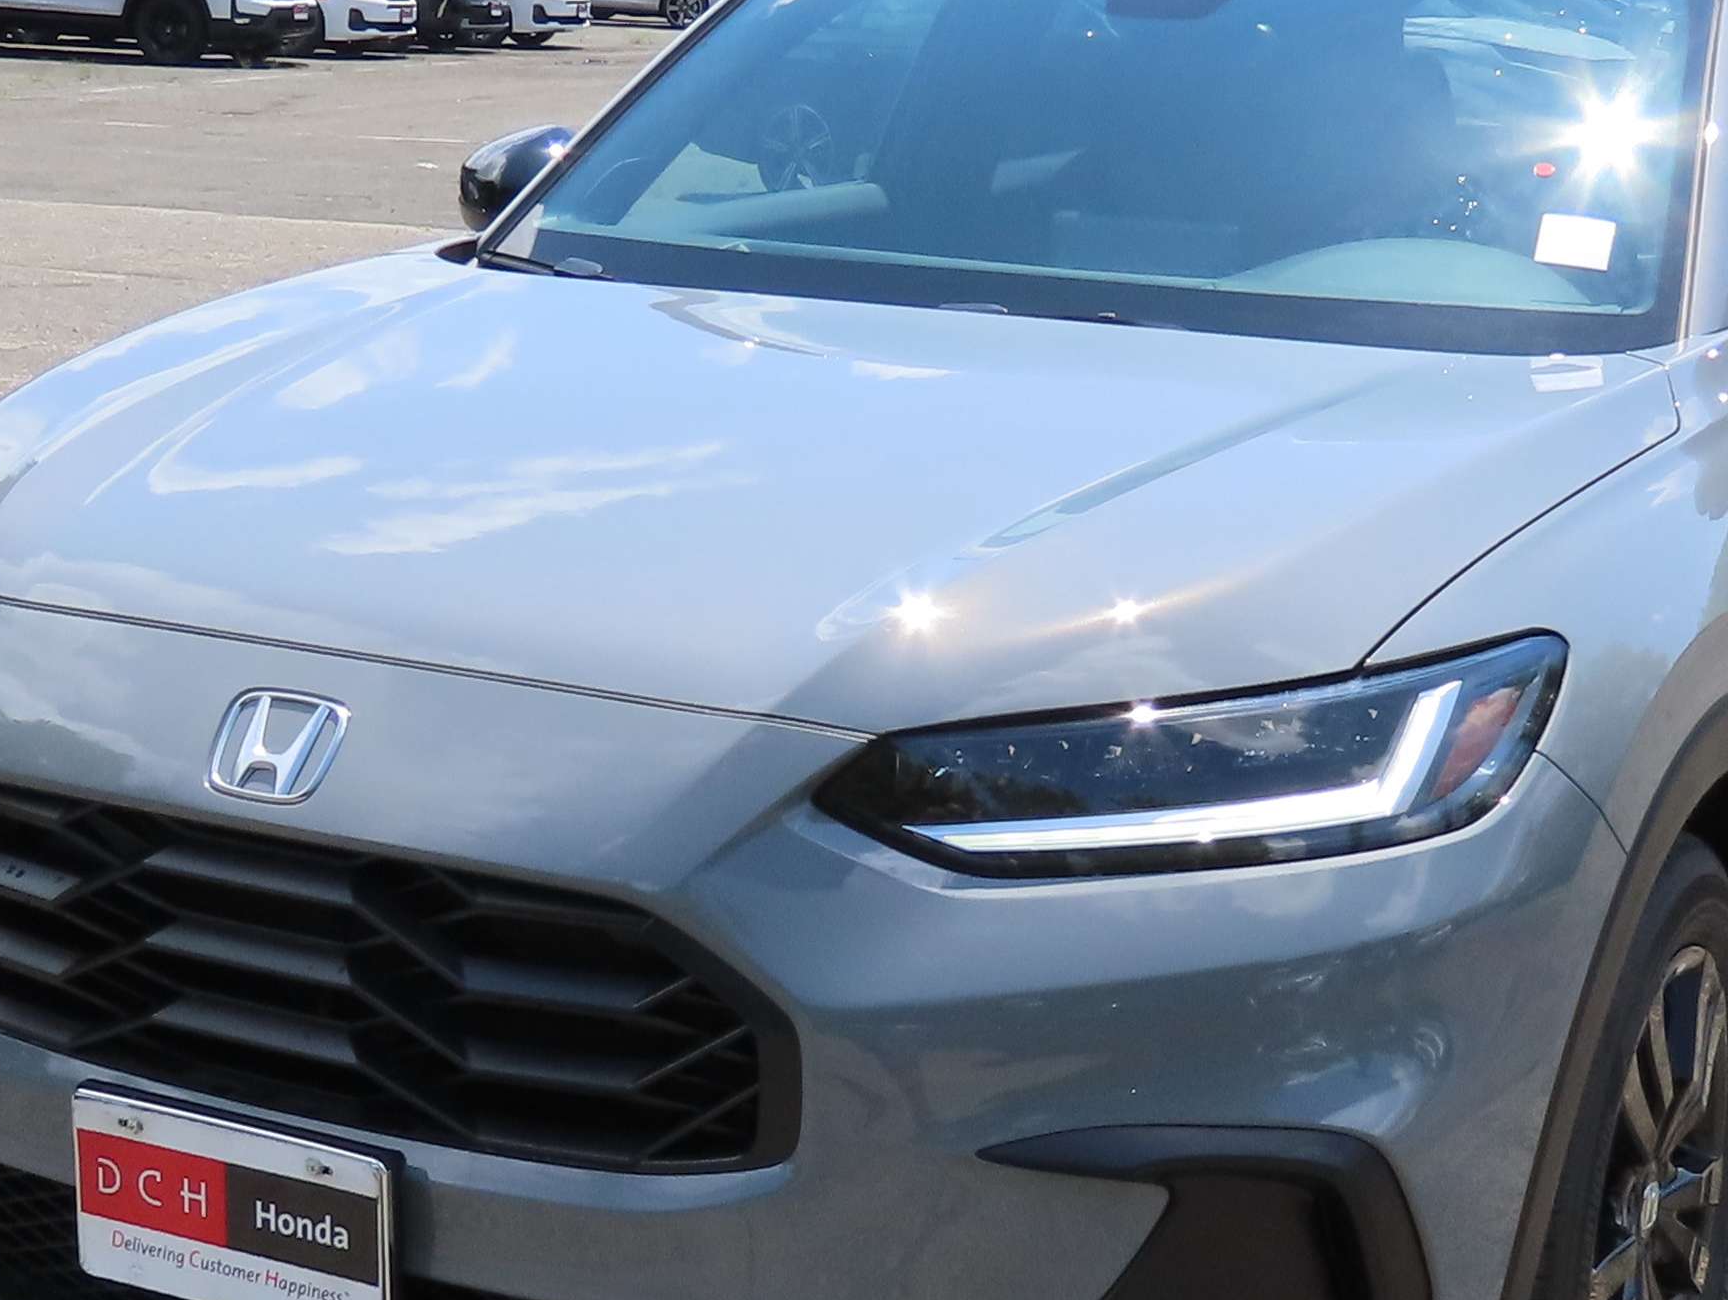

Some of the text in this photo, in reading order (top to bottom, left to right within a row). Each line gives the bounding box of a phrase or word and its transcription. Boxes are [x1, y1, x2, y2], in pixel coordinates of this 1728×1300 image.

[254, 1199, 350, 1251] Honda
[111, 1228, 186, 1270] Delivering
[188, 1248, 262, 1283] Customer
